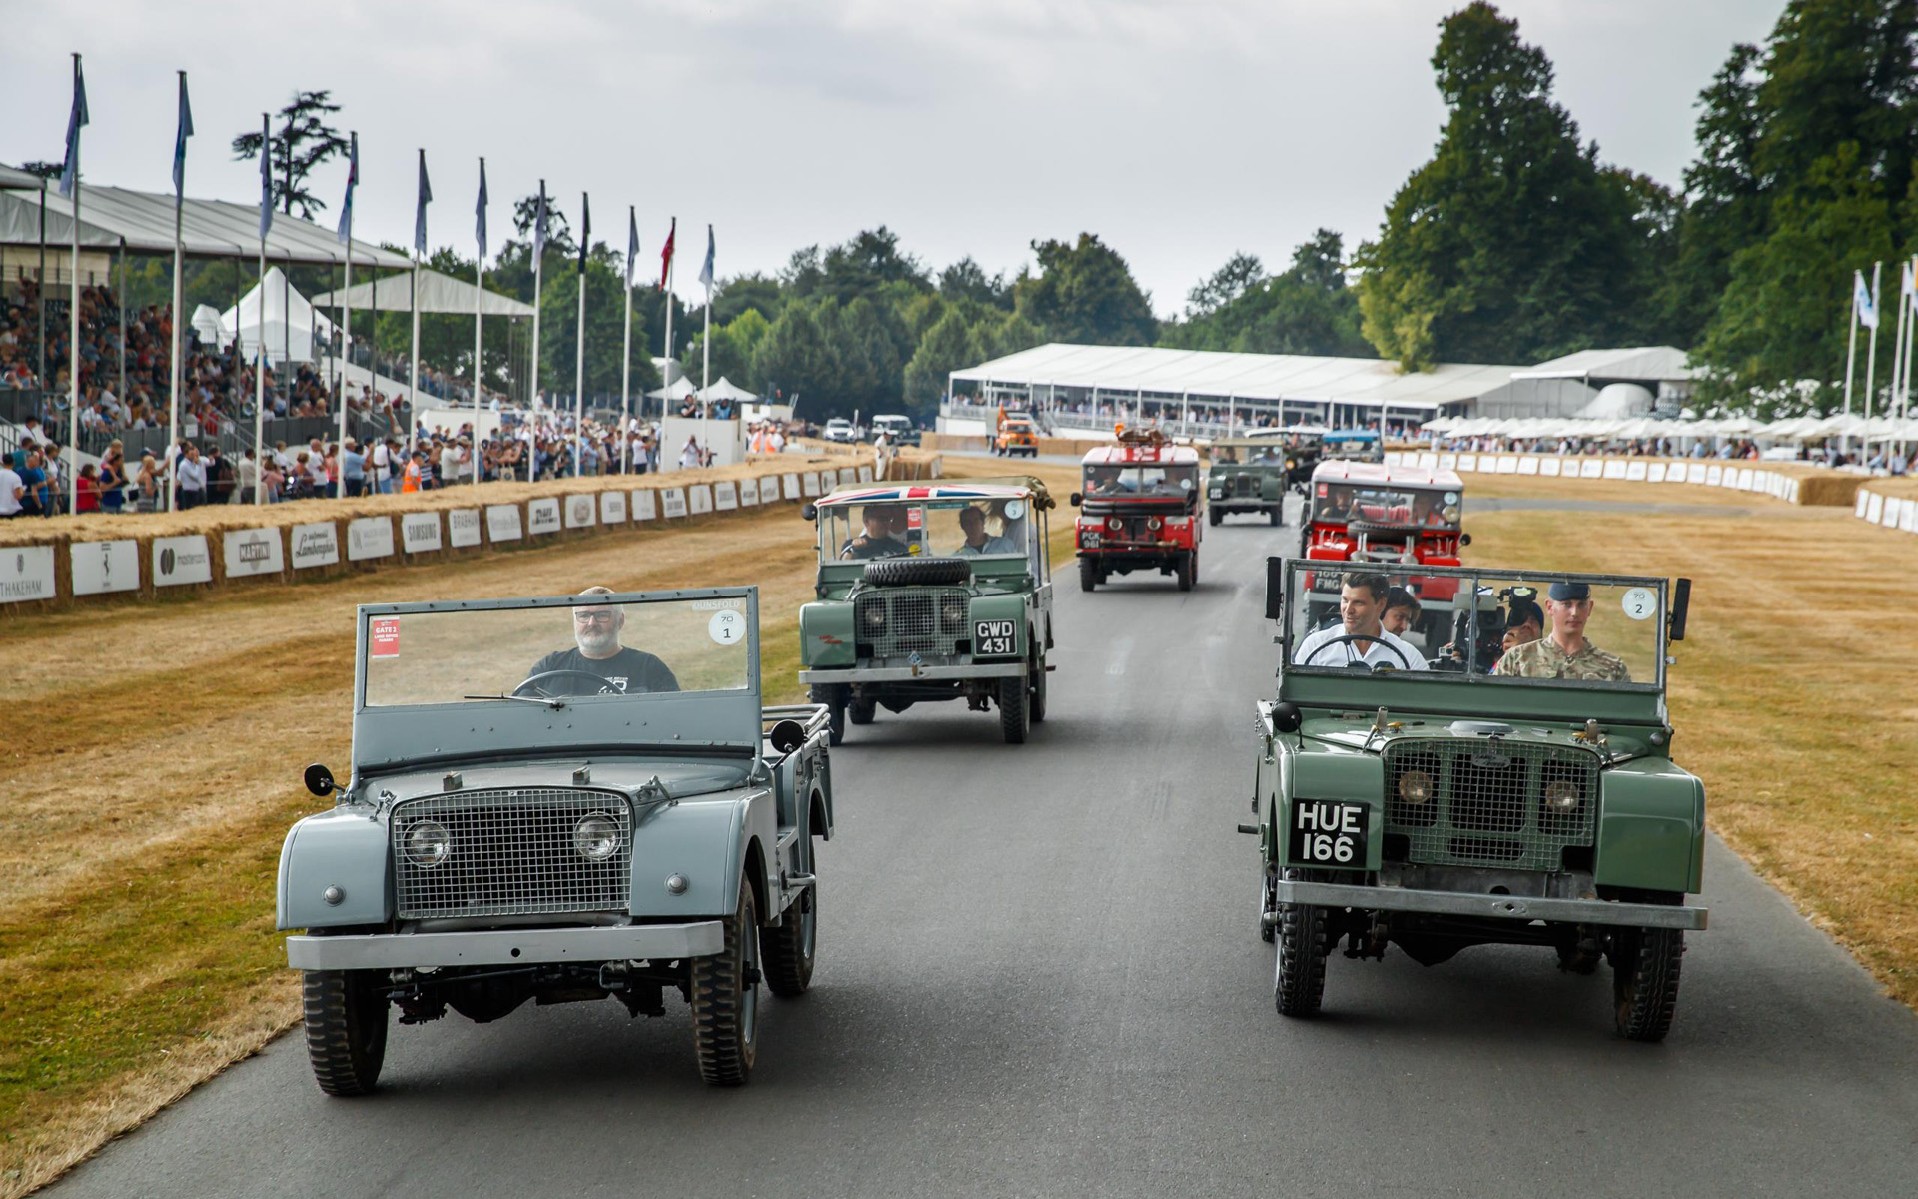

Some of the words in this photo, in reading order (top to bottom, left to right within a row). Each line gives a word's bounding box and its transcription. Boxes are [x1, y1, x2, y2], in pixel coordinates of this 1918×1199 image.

[407, 522, 437, 542] SAMSUNG
[240, 543, 269, 561] MARTINI
[1635, 603, 1643, 614] 2
[723, 628, 731, 638] 1
[978, 621, 1013, 637] GWD
[982, 637, 1010, 653] 431
[1298, 803, 1362, 833] HUE
[1303, 833, 1354, 862] 166
